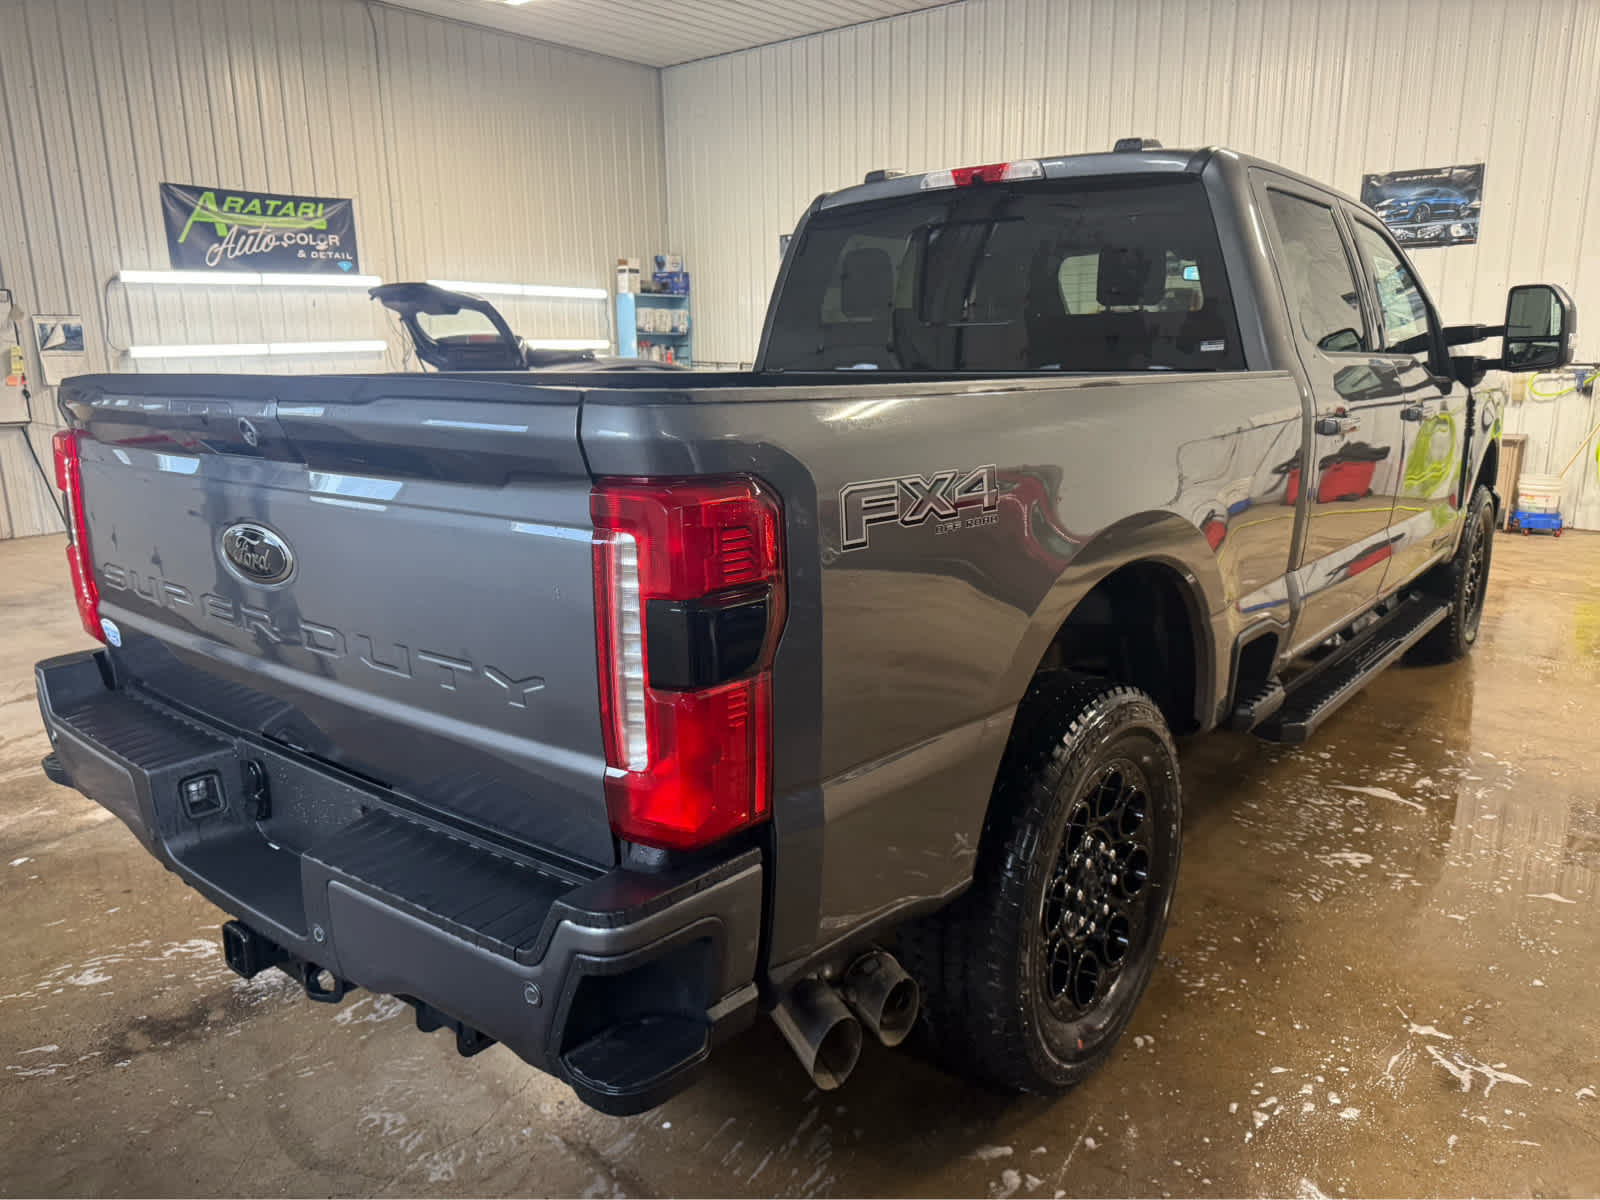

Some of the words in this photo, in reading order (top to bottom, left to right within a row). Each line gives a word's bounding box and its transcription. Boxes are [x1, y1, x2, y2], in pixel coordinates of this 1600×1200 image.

[205, 224, 280, 267] Auto
[283, 232, 341, 250] COLOR
[297, 249, 307, 259] &
[311, 251, 353, 260] DETAIL
[839, 464, 1000, 552] FX4
[235, 535, 272, 571] Ford
[103, 562, 282, 642] SUPER
[300, 618, 546, 709] DUTY
